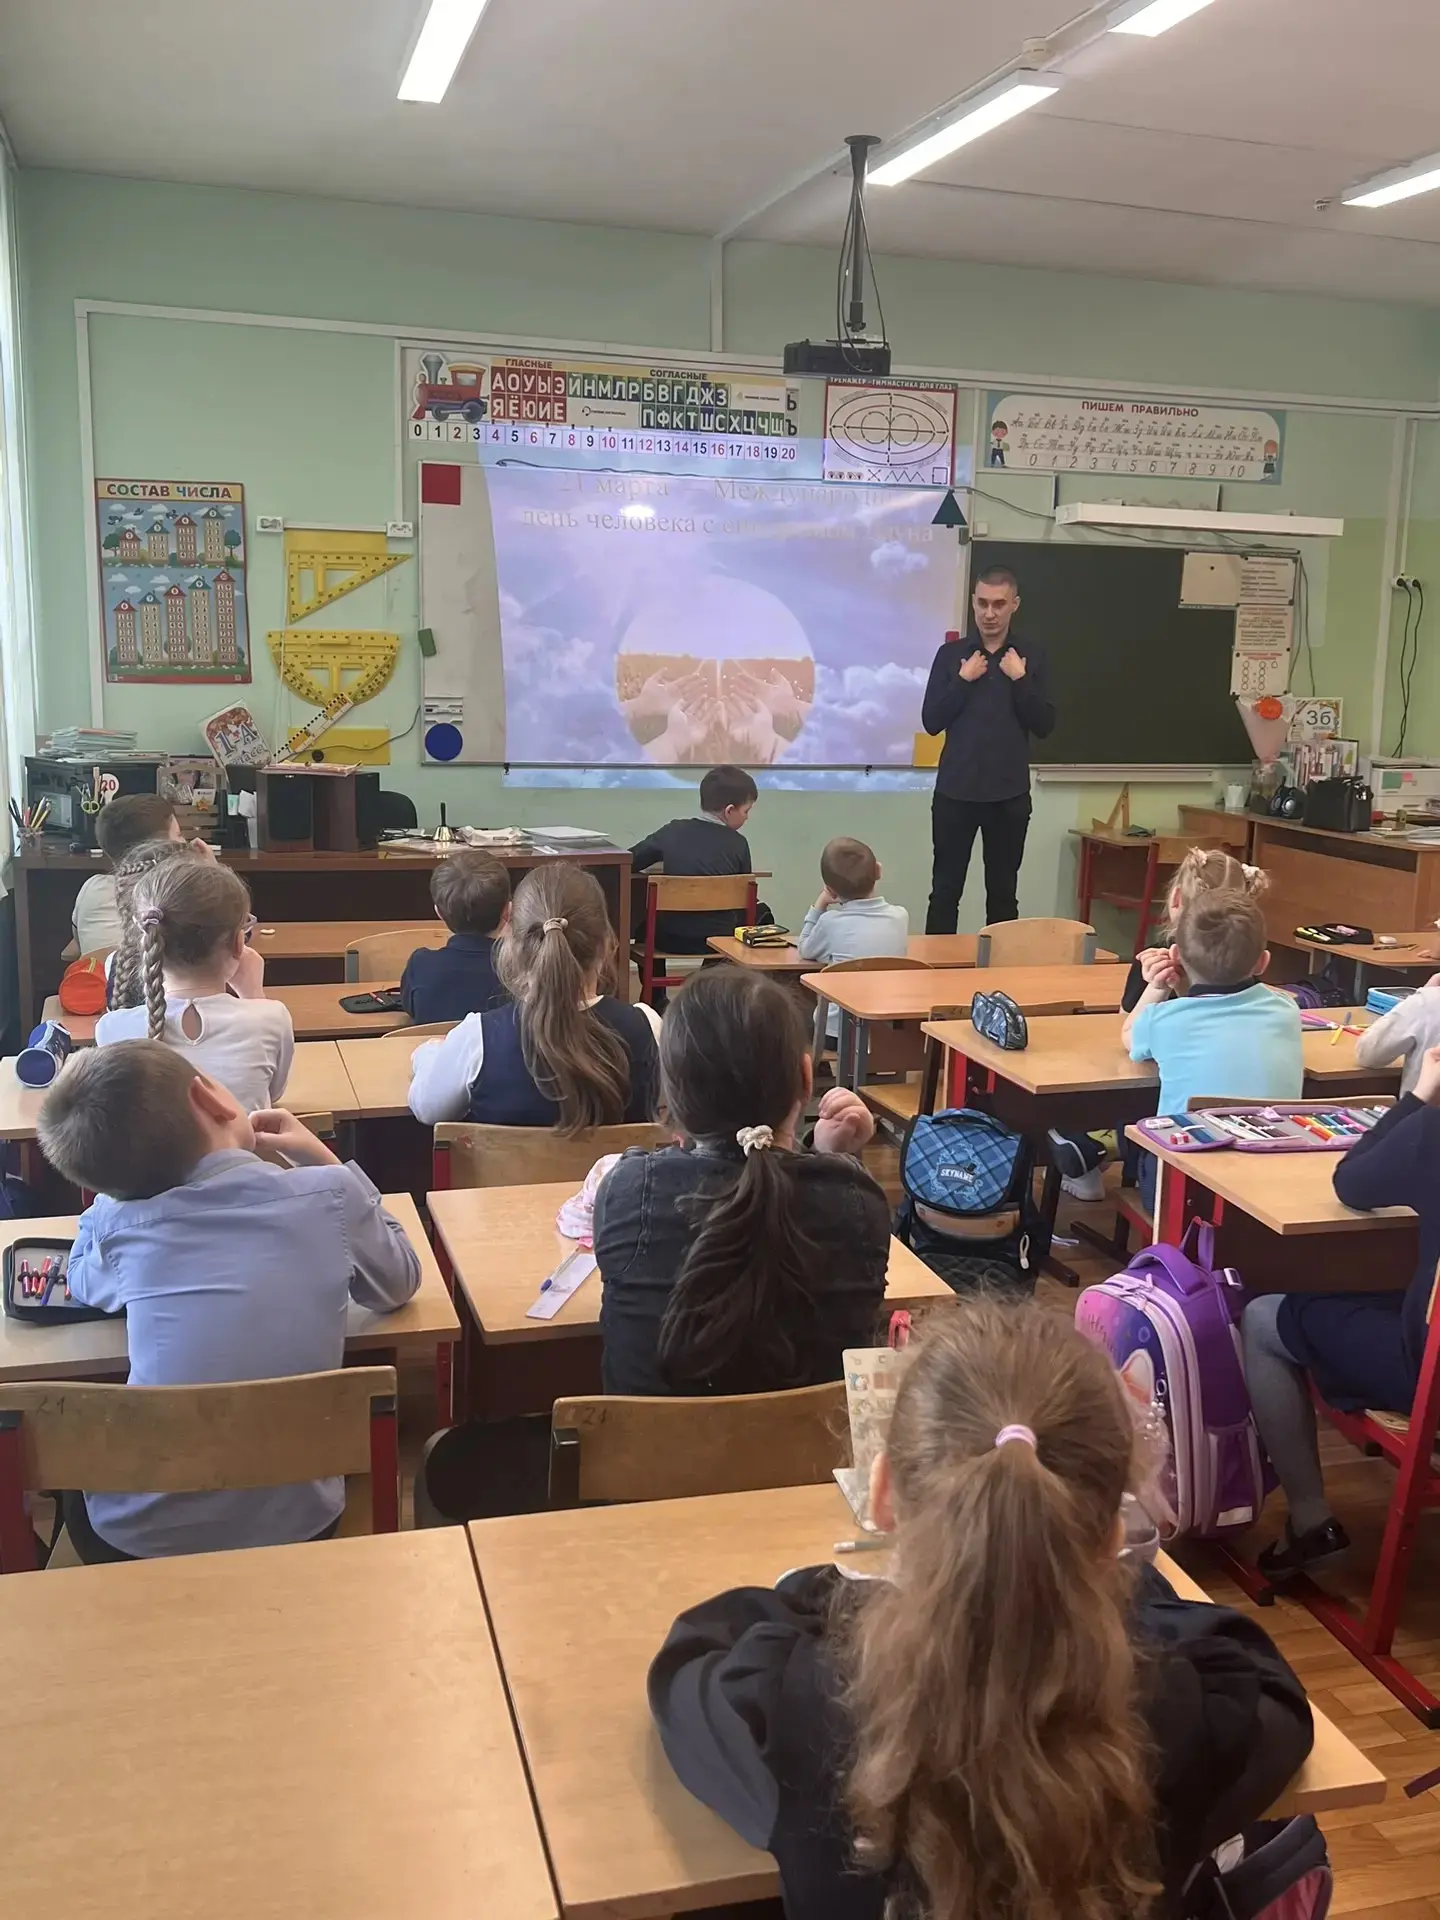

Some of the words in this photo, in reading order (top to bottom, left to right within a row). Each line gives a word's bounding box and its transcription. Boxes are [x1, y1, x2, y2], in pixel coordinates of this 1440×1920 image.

[505, 358, 553, 369] ГЛАСНЫЕ
[649, 368, 708, 380] СОГЛАСНЫЕ
[1081, 401, 1125, 413] ПИШЕМ
[1131, 404, 1199, 417] ПРАВИЛЬНО
[414, 424, 422, 437] 0
[435, 425, 441, 438] 1
[453, 427, 461, 439] 2
[473, 427, 480, 440] 3
[492, 429, 500, 441] 4
[511, 430, 519, 442] 5
[530, 431, 538, 443] 6
[549, 432, 557, 444] 7
[568, 433, 576, 446] 8
[586, 434, 594, 447] 9
[602, 436, 616, 449] 10
[622, 437, 634, 450] 11
[639, 438, 653, 451] 12
[657, 439, 671, 452] 13
[675, 441, 689, 453] 14
[693, 441, 707, 454] 15
[711, 443, 725, 456] 16
[729, 444, 743, 456] 17
[747, 445, 760, 457] 18
[764, 446, 778, 459] 19
[781, 447, 796, 460] 20
[1029, 453, 1038, 467] 0
[1052, 455, 1058, 467] 1
[1069, 456, 1078, 469] 2
[1089, 457, 1098, 470] 3
[1111, 459, 1118, 471] 4
[1130, 460, 1138, 472] 5
[1149, 460, 1157, 473] 6
[1170, 461, 1178, 474] 7
[1189, 462, 1197, 476] 8
[1208, 463, 1216, 476] 9
[1229, 465, 1246, 478] 10
[107, 484, 171, 497] СОСТАВ
[176, 486, 232, 499] ЧИСЛА
[596, 478, 670, 501] марта
[522, 509, 580, 529] день
[586, 512, 696, 532] человека
